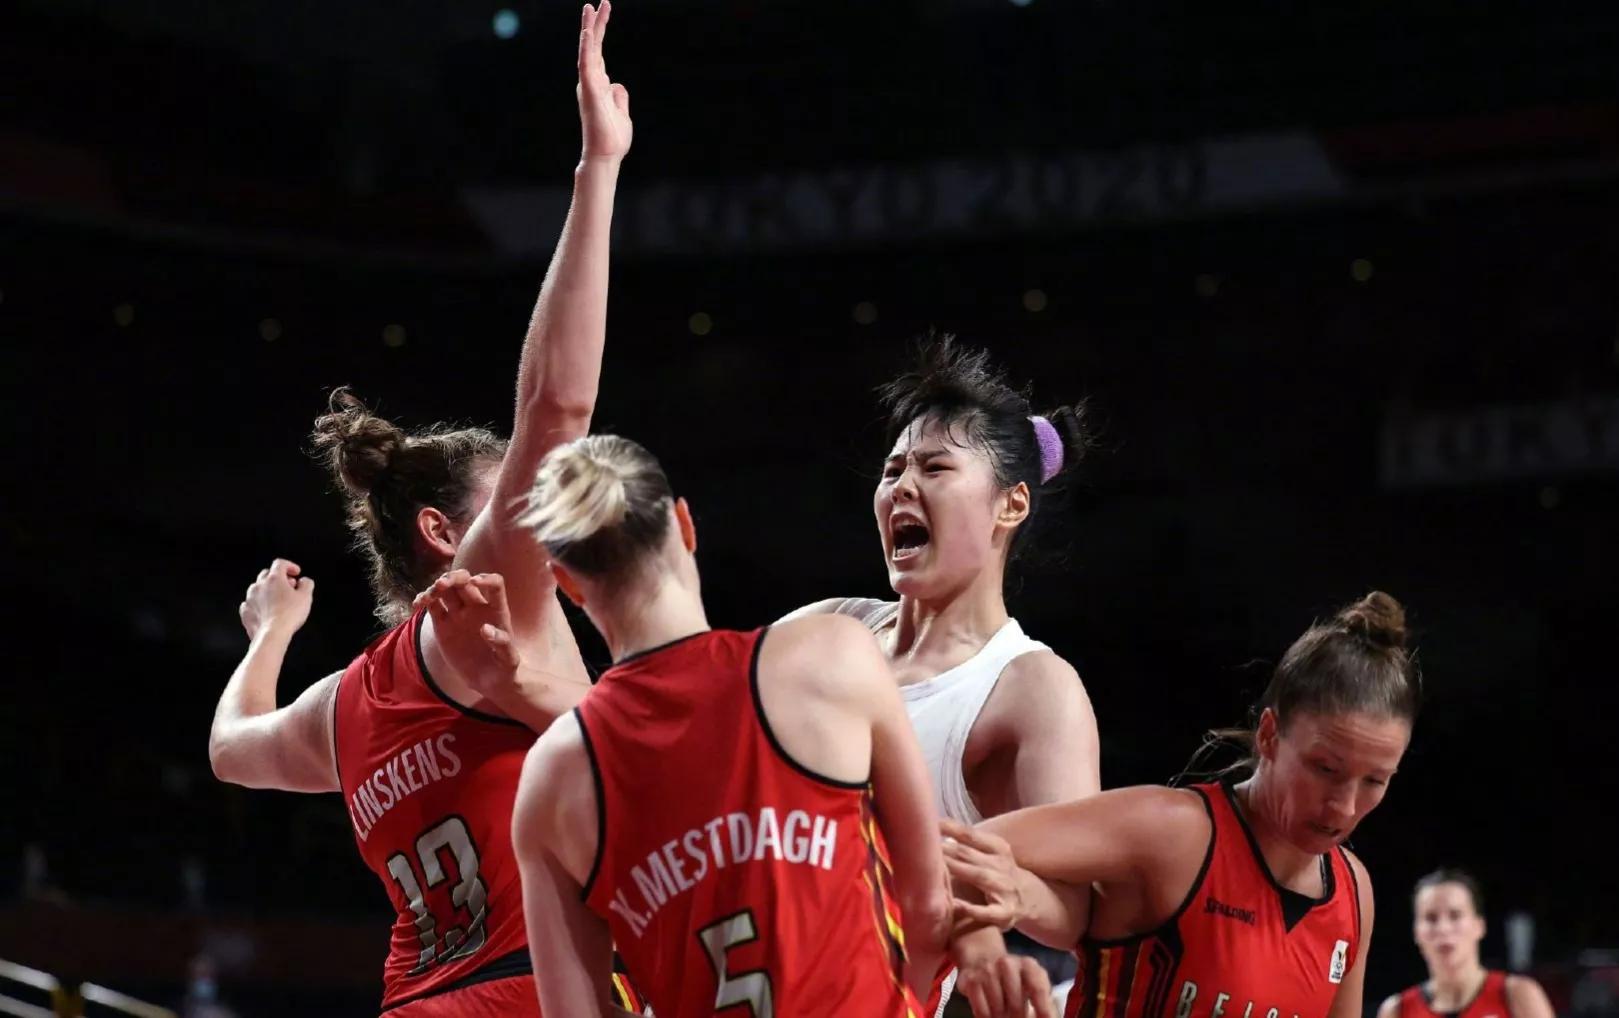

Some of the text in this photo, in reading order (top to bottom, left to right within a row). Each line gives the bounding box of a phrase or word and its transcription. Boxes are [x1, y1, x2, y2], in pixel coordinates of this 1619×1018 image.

[974, 146, 1203, 232] 2020
[349, 732, 462, 842] LINSKENS
[386, 815, 487, 976] 13
[608, 806, 838, 939] K.MESTDAGH
[697, 907, 774, 1018] 5
